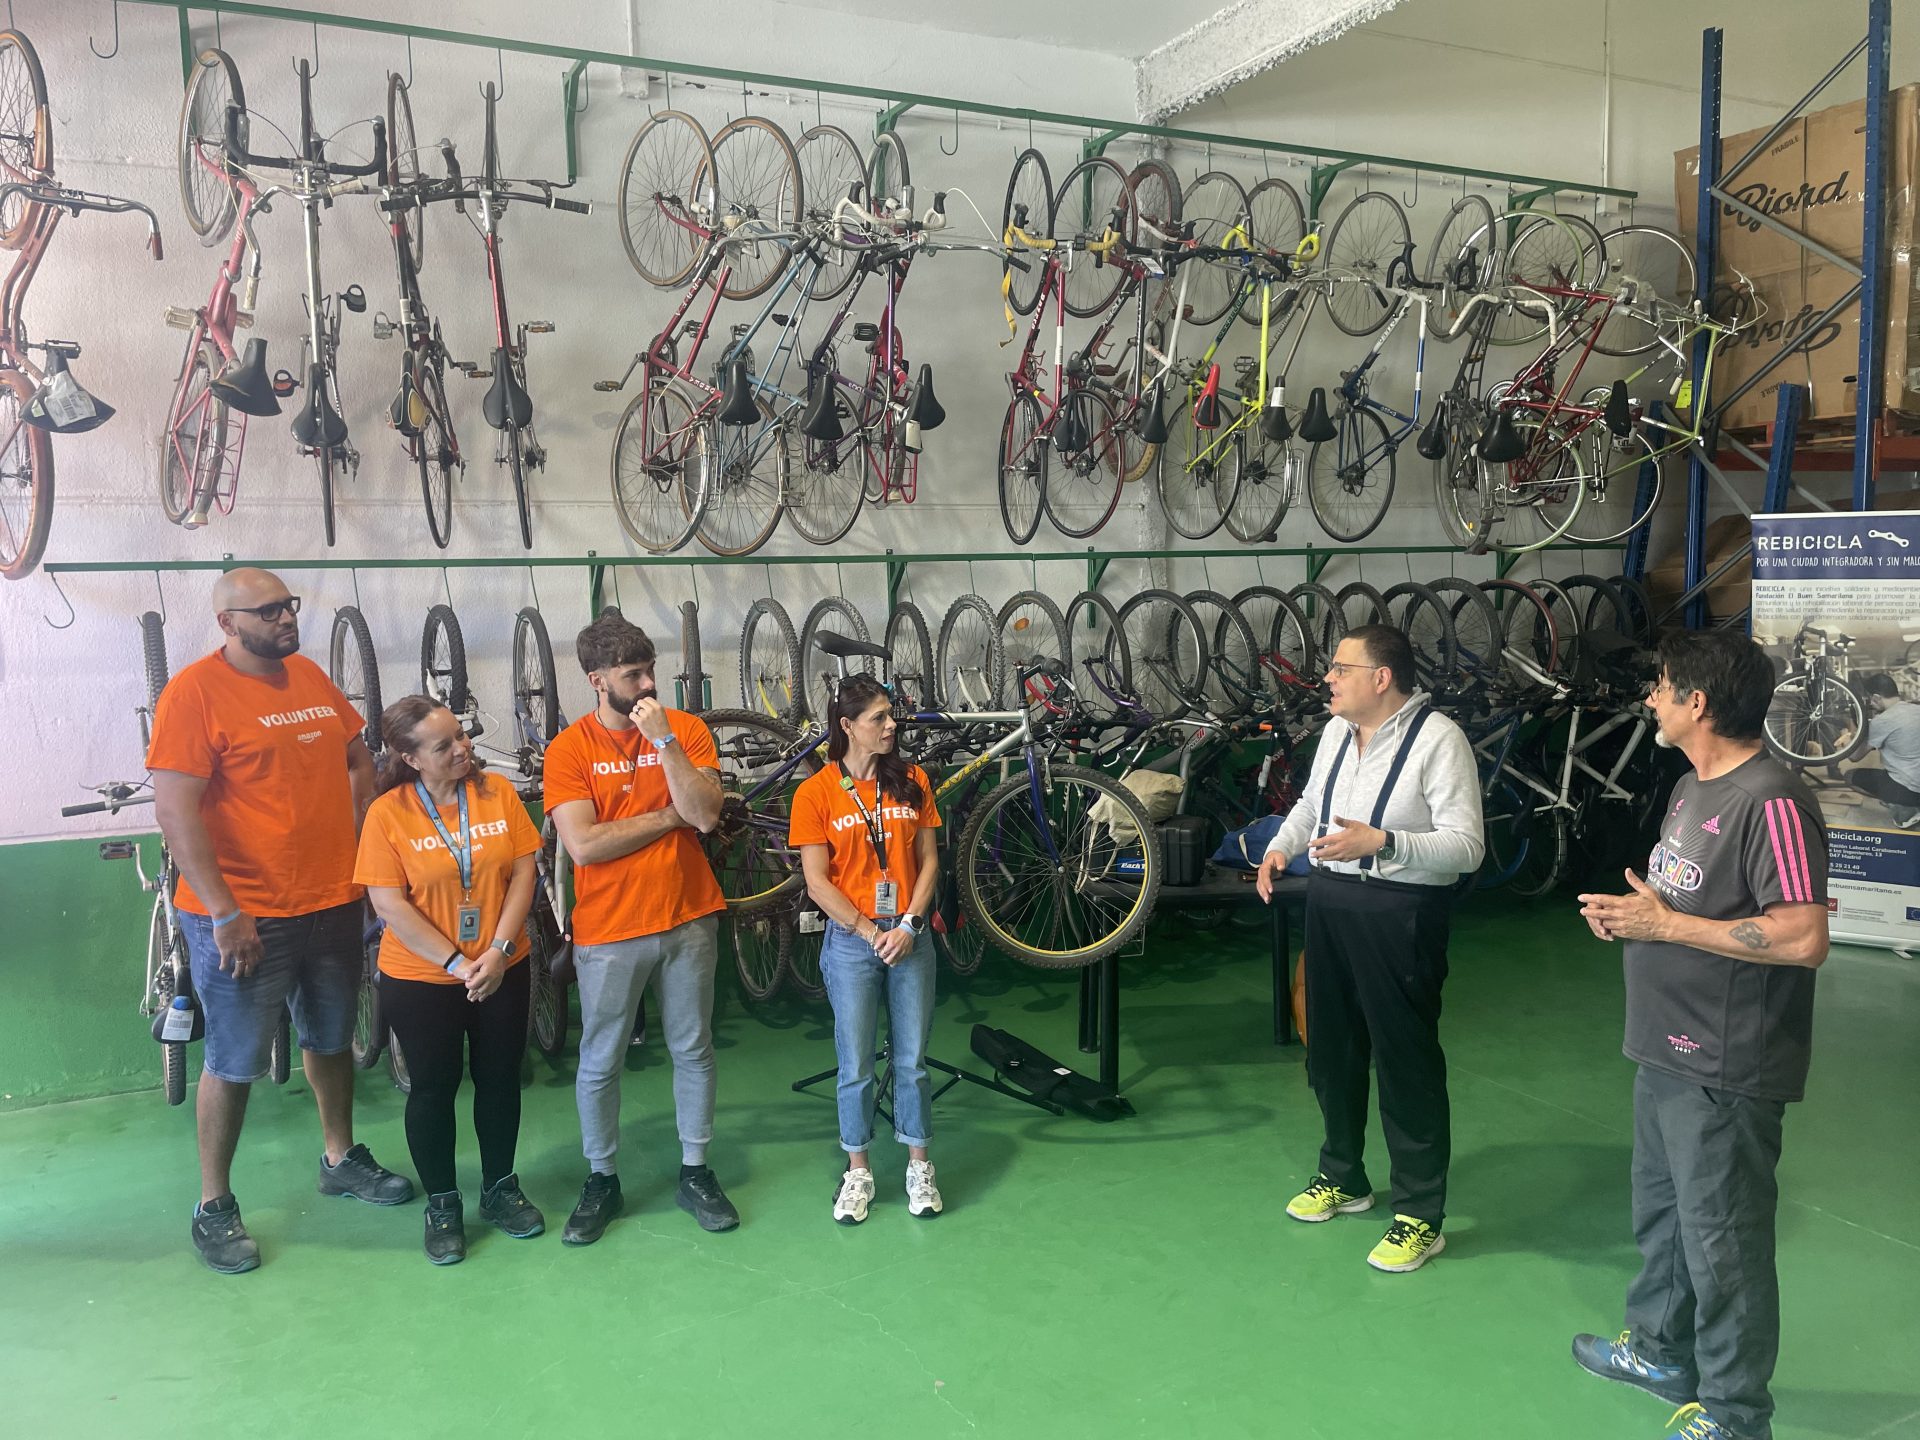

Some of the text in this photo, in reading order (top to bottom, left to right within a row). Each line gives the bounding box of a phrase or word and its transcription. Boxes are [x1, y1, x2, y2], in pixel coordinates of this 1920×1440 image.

[1757, 535, 1863, 550] REBICICLA
[1756, 557, 1769, 567] POR
[1772, 557, 1788, 567] UNA
[1791, 556, 1818, 567] CIUDAD
[1822, 556, 1873, 567] INTEGRADORA
[1877, 556, 1883, 566] Y
[1886, 556, 1900, 566] SIN
[258, 706, 338, 728] VOLUNTEER
[297, 730, 322, 743] amazon
[832, 805, 919, 832] VOLTEER
[410, 819, 508, 852] VOLTEER
